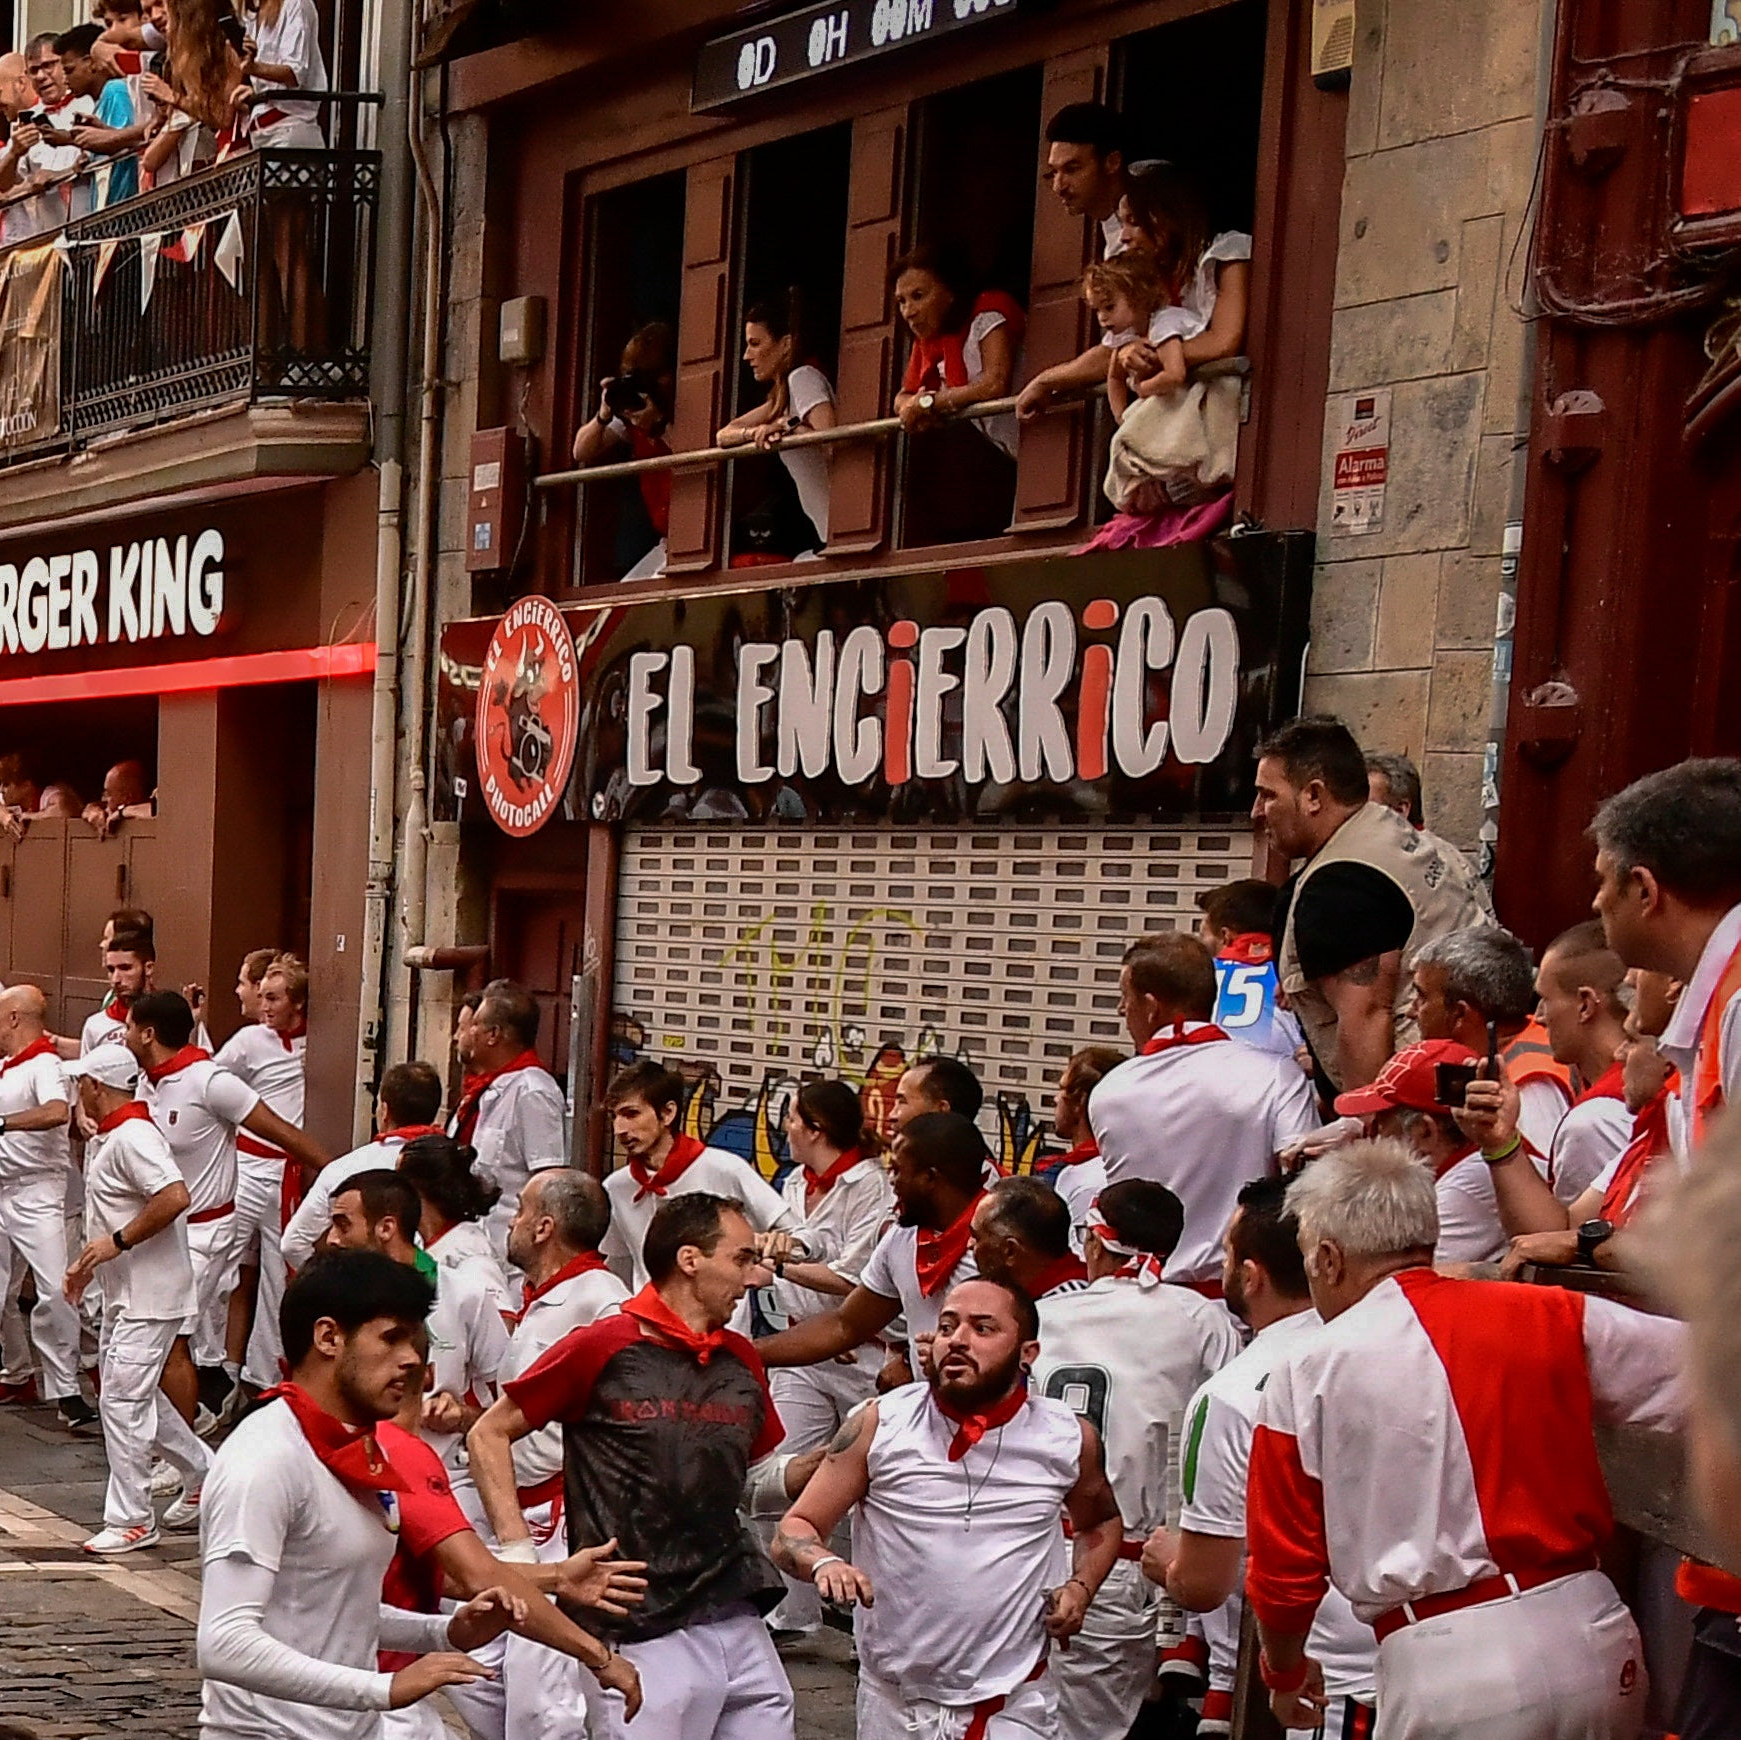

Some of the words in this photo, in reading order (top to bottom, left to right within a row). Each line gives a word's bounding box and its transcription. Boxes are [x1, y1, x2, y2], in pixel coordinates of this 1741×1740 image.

[1338, 455, 1386, 475] Alarma
[107, 528, 225, 643] KING
[627, 644, 704, 787] EL
[485, 773, 555, 828] PHOTOCALL
